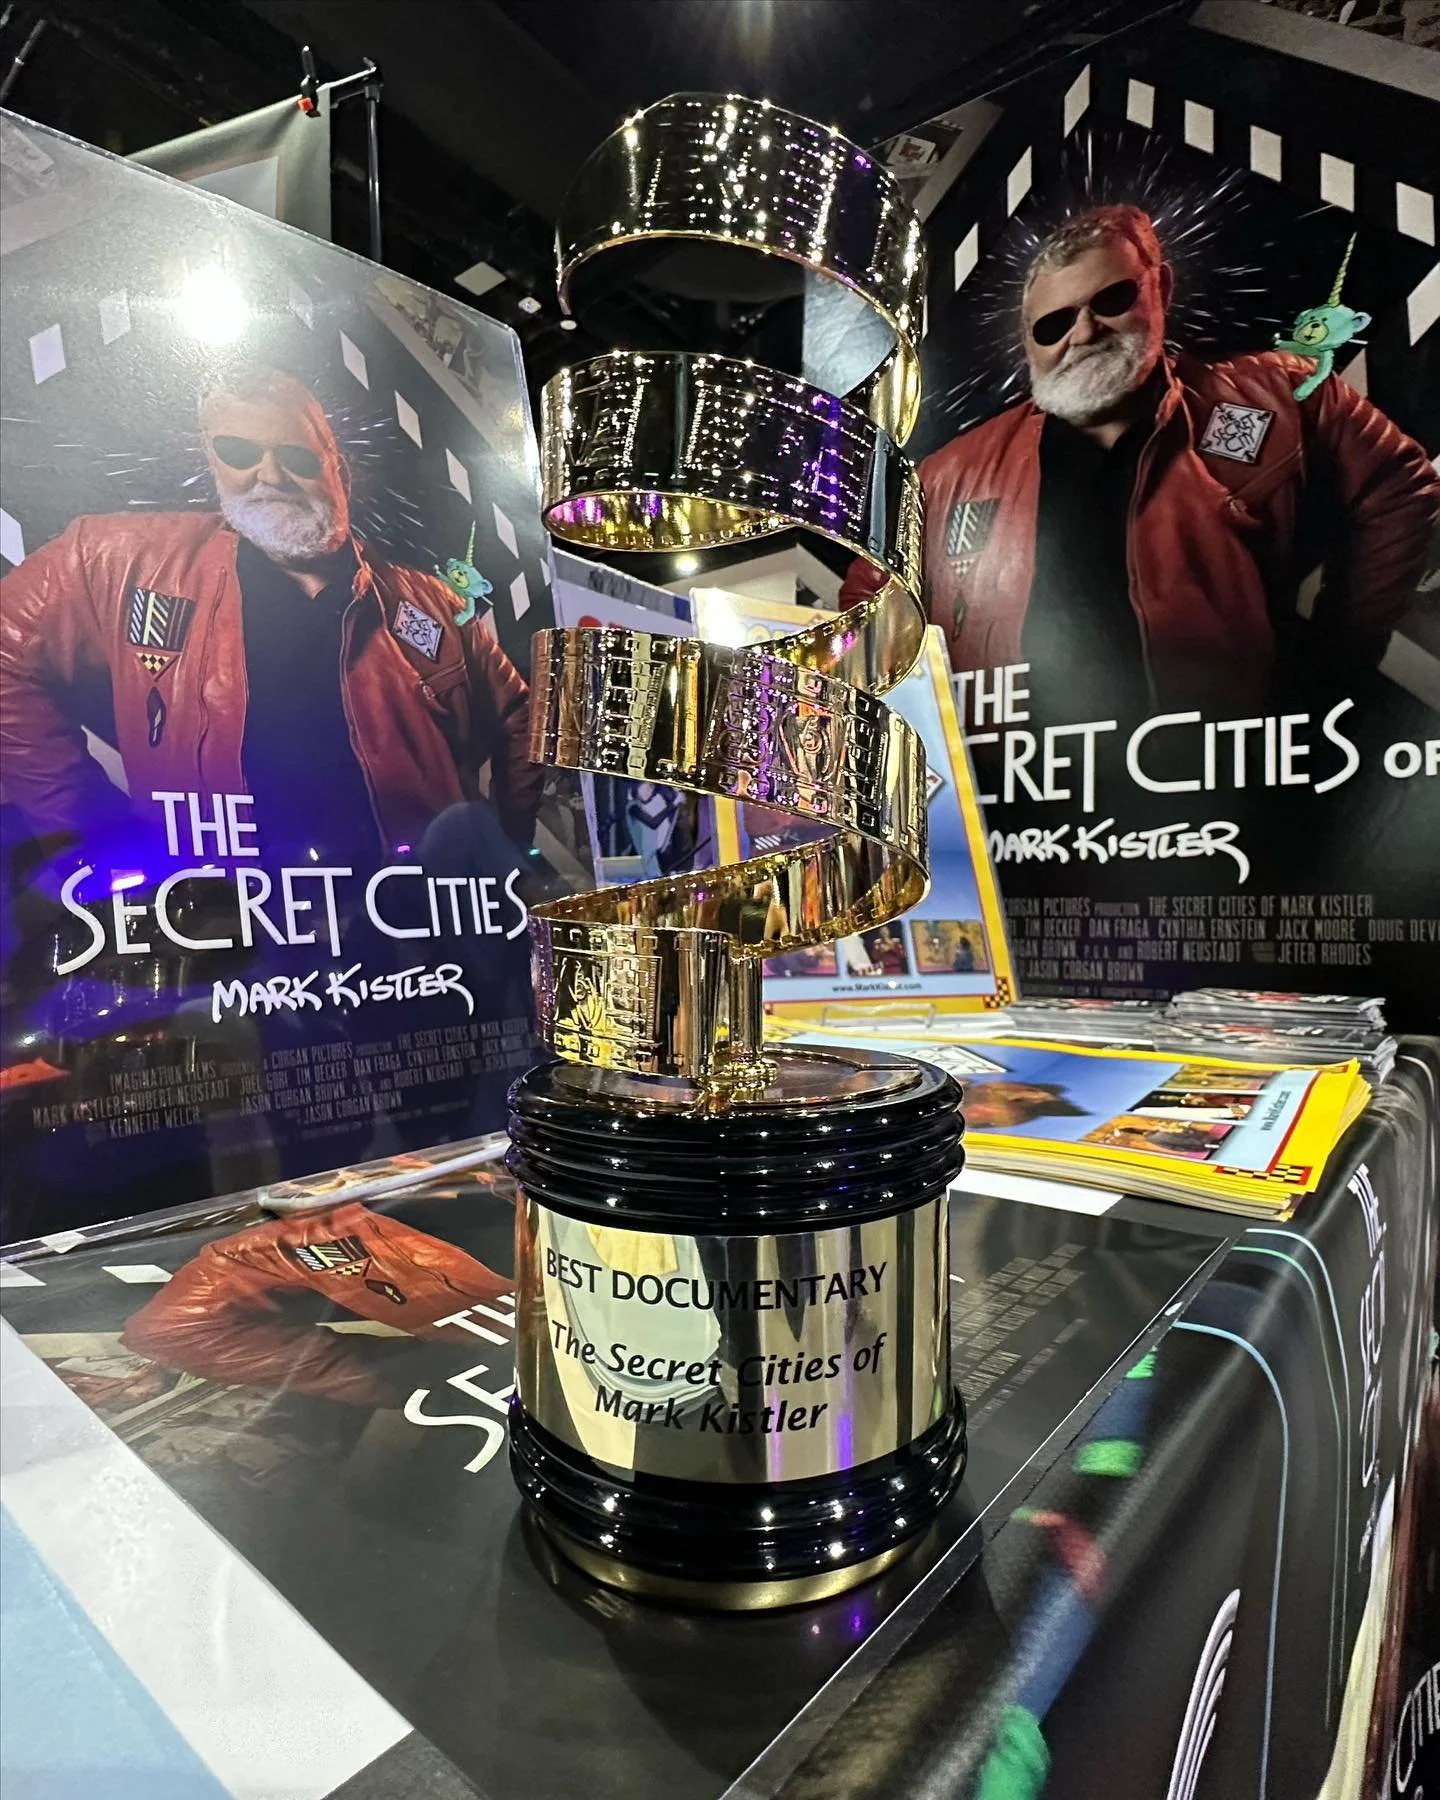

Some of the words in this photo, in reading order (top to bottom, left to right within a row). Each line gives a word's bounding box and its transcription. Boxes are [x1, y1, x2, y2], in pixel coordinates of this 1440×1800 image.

[953, 663, 1030, 728] THE
[1126, 697, 1360, 794] CITIES
[152, 791, 260, 856] THE
[1073, 818, 1250, 884] KISTLER
[57, 865, 353, 976] SECRET
[365, 865, 529, 940] CITIES
[1088, 918, 1110, 938] DAN
[1114, 918, 1149, 939] FRAGA
[1158, 918, 1206, 939] CYNTHIA
[1211, 918, 1266, 940] ERNSTEIN
[1276, 919, 1309, 941] JACK
[1315, 919, 1357, 942] MOORE
[1368, 919, 1404, 942] DOUG
[1149, 895, 1168, 917] THE
[1172, 895, 1213, 917] SECRET
[1218, 895, 1256, 917] CITIES
[1261, 895, 1275, 917] OF
[1281, 894, 1315, 917] MARK
[1320, 894, 1374, 917] KISTLER
[1107, 961, 1144, 981] BROWN
[1136, 940, 1178, 961] ROBERT
[1182, 941, 1242, 963] NEUSTADT
[1278, 942, 1316, 965] JETER
[1321, 943, 1373, 966] RHODES
[211, 970, 323, 1023] MARK
[326, 963, 475, 1017] KISTLER
[177, 1079, 230, 1104] NEUSTADT
[239, 1093, 272, 1117] JASON
[546, 1247, 603, 1295] BEST
[612, 1262, 888, 1313] DOCUMENTARY
[550, 1319, 596, 1365] The
[610, 1343, 721, 1387] Secret
[737, 1351, 841, 1388] Cities
[853, 1332, 887, 1375] of
[594, 1385, 684, 1430] Mark
[700, 1400, 829, 1434] Kistler
